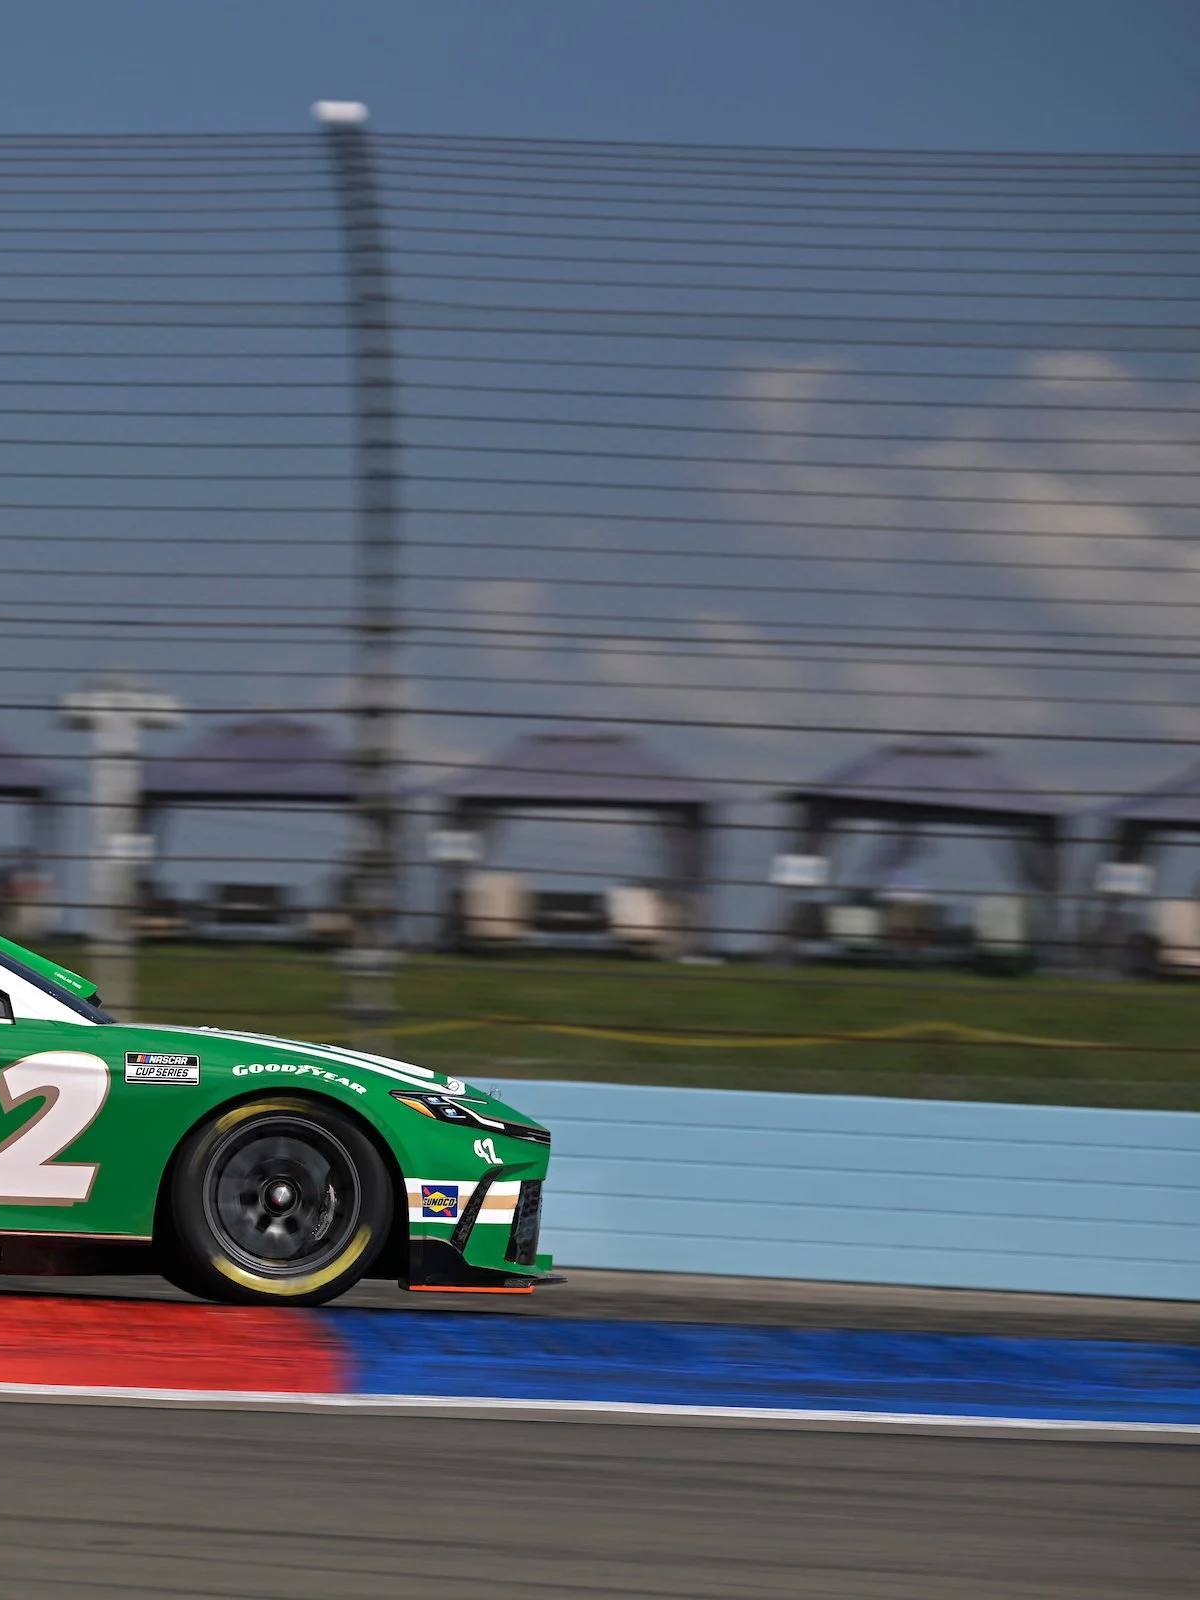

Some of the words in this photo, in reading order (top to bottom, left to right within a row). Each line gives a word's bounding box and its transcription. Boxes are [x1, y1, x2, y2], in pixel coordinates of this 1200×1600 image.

[149, 1055, 188, 1065] NASCAR
[135, 1067, 155, 1076] CUP
[156, 1068, 189, 1077] SERIES
[232, 1063, 367, 1095] GOODYEAR
[473, 1138, 503, 1164] 42
[423, 1197, 457, 1207] SUNOCO
